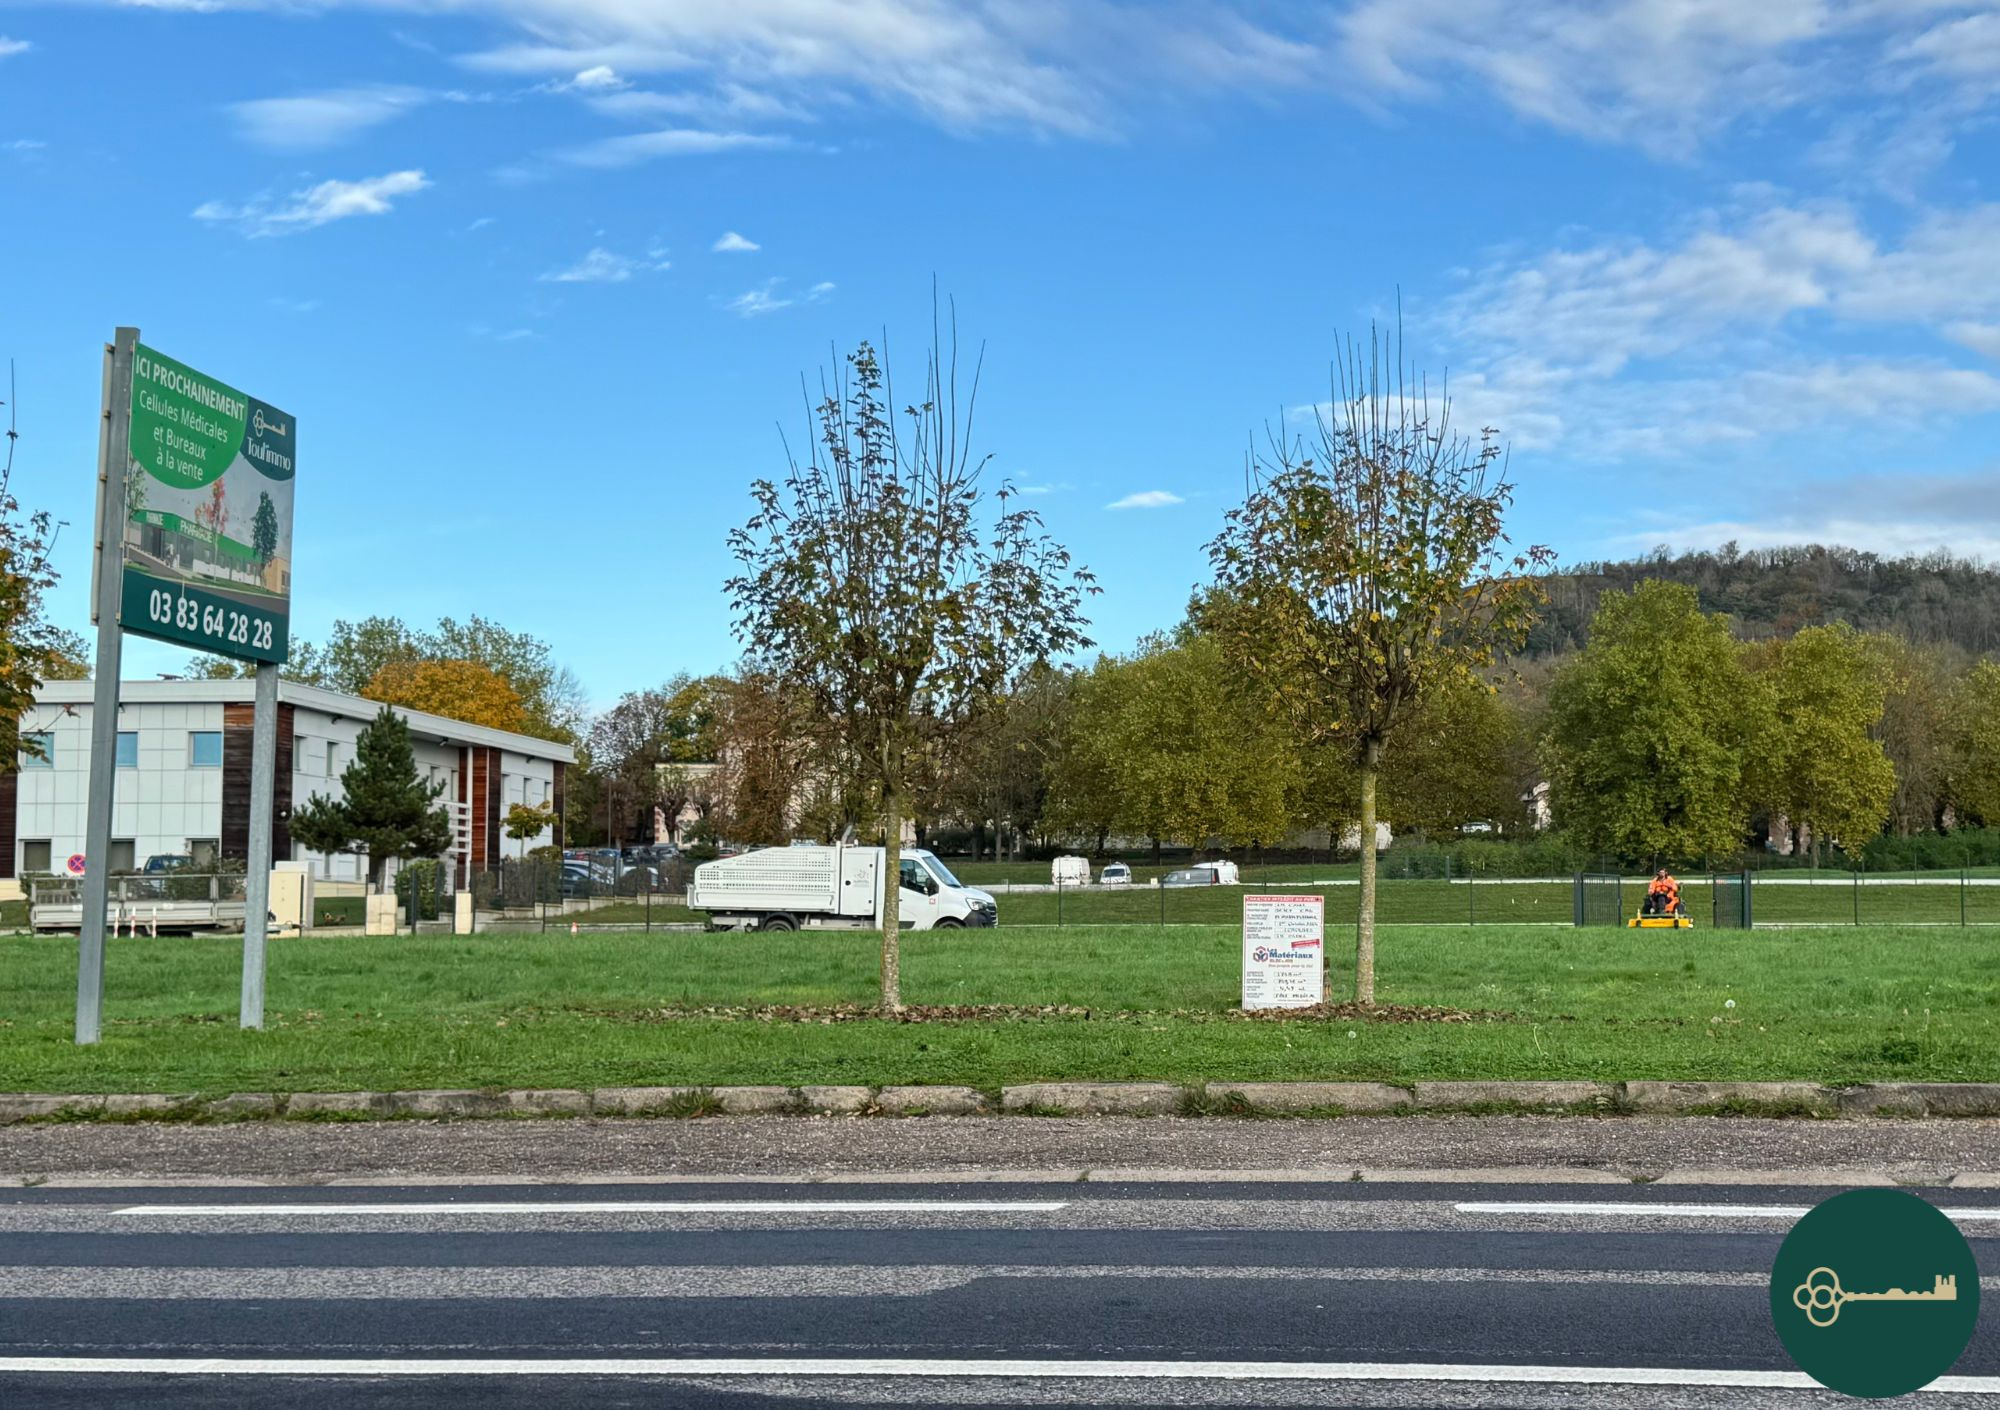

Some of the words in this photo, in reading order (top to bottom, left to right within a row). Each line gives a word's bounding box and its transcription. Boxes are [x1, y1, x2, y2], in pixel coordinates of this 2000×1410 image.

[136, 354, 150, 379] ICI
[153, 363, 245, 421] PROCHAINEMENT
[140, 390, 178, 422] Cellules
[180, 407, 228, 443] Médicales
[154, 426, 163, 443] et
[166, 428, 206, 460] Bureaux
[156, 446, 163, 465] à
[166, 450, 174, 469] la
[177, 459, 203, 481] vente
[150, 589, 171, 624] 03
[176, 597, 198, 631] 83
[203, 605, 224, 638] 64
[228, 611, 248, 644] 28
[252, 618, 272, 650] 28
[1269, 951, 1313, 959] Matériaux
